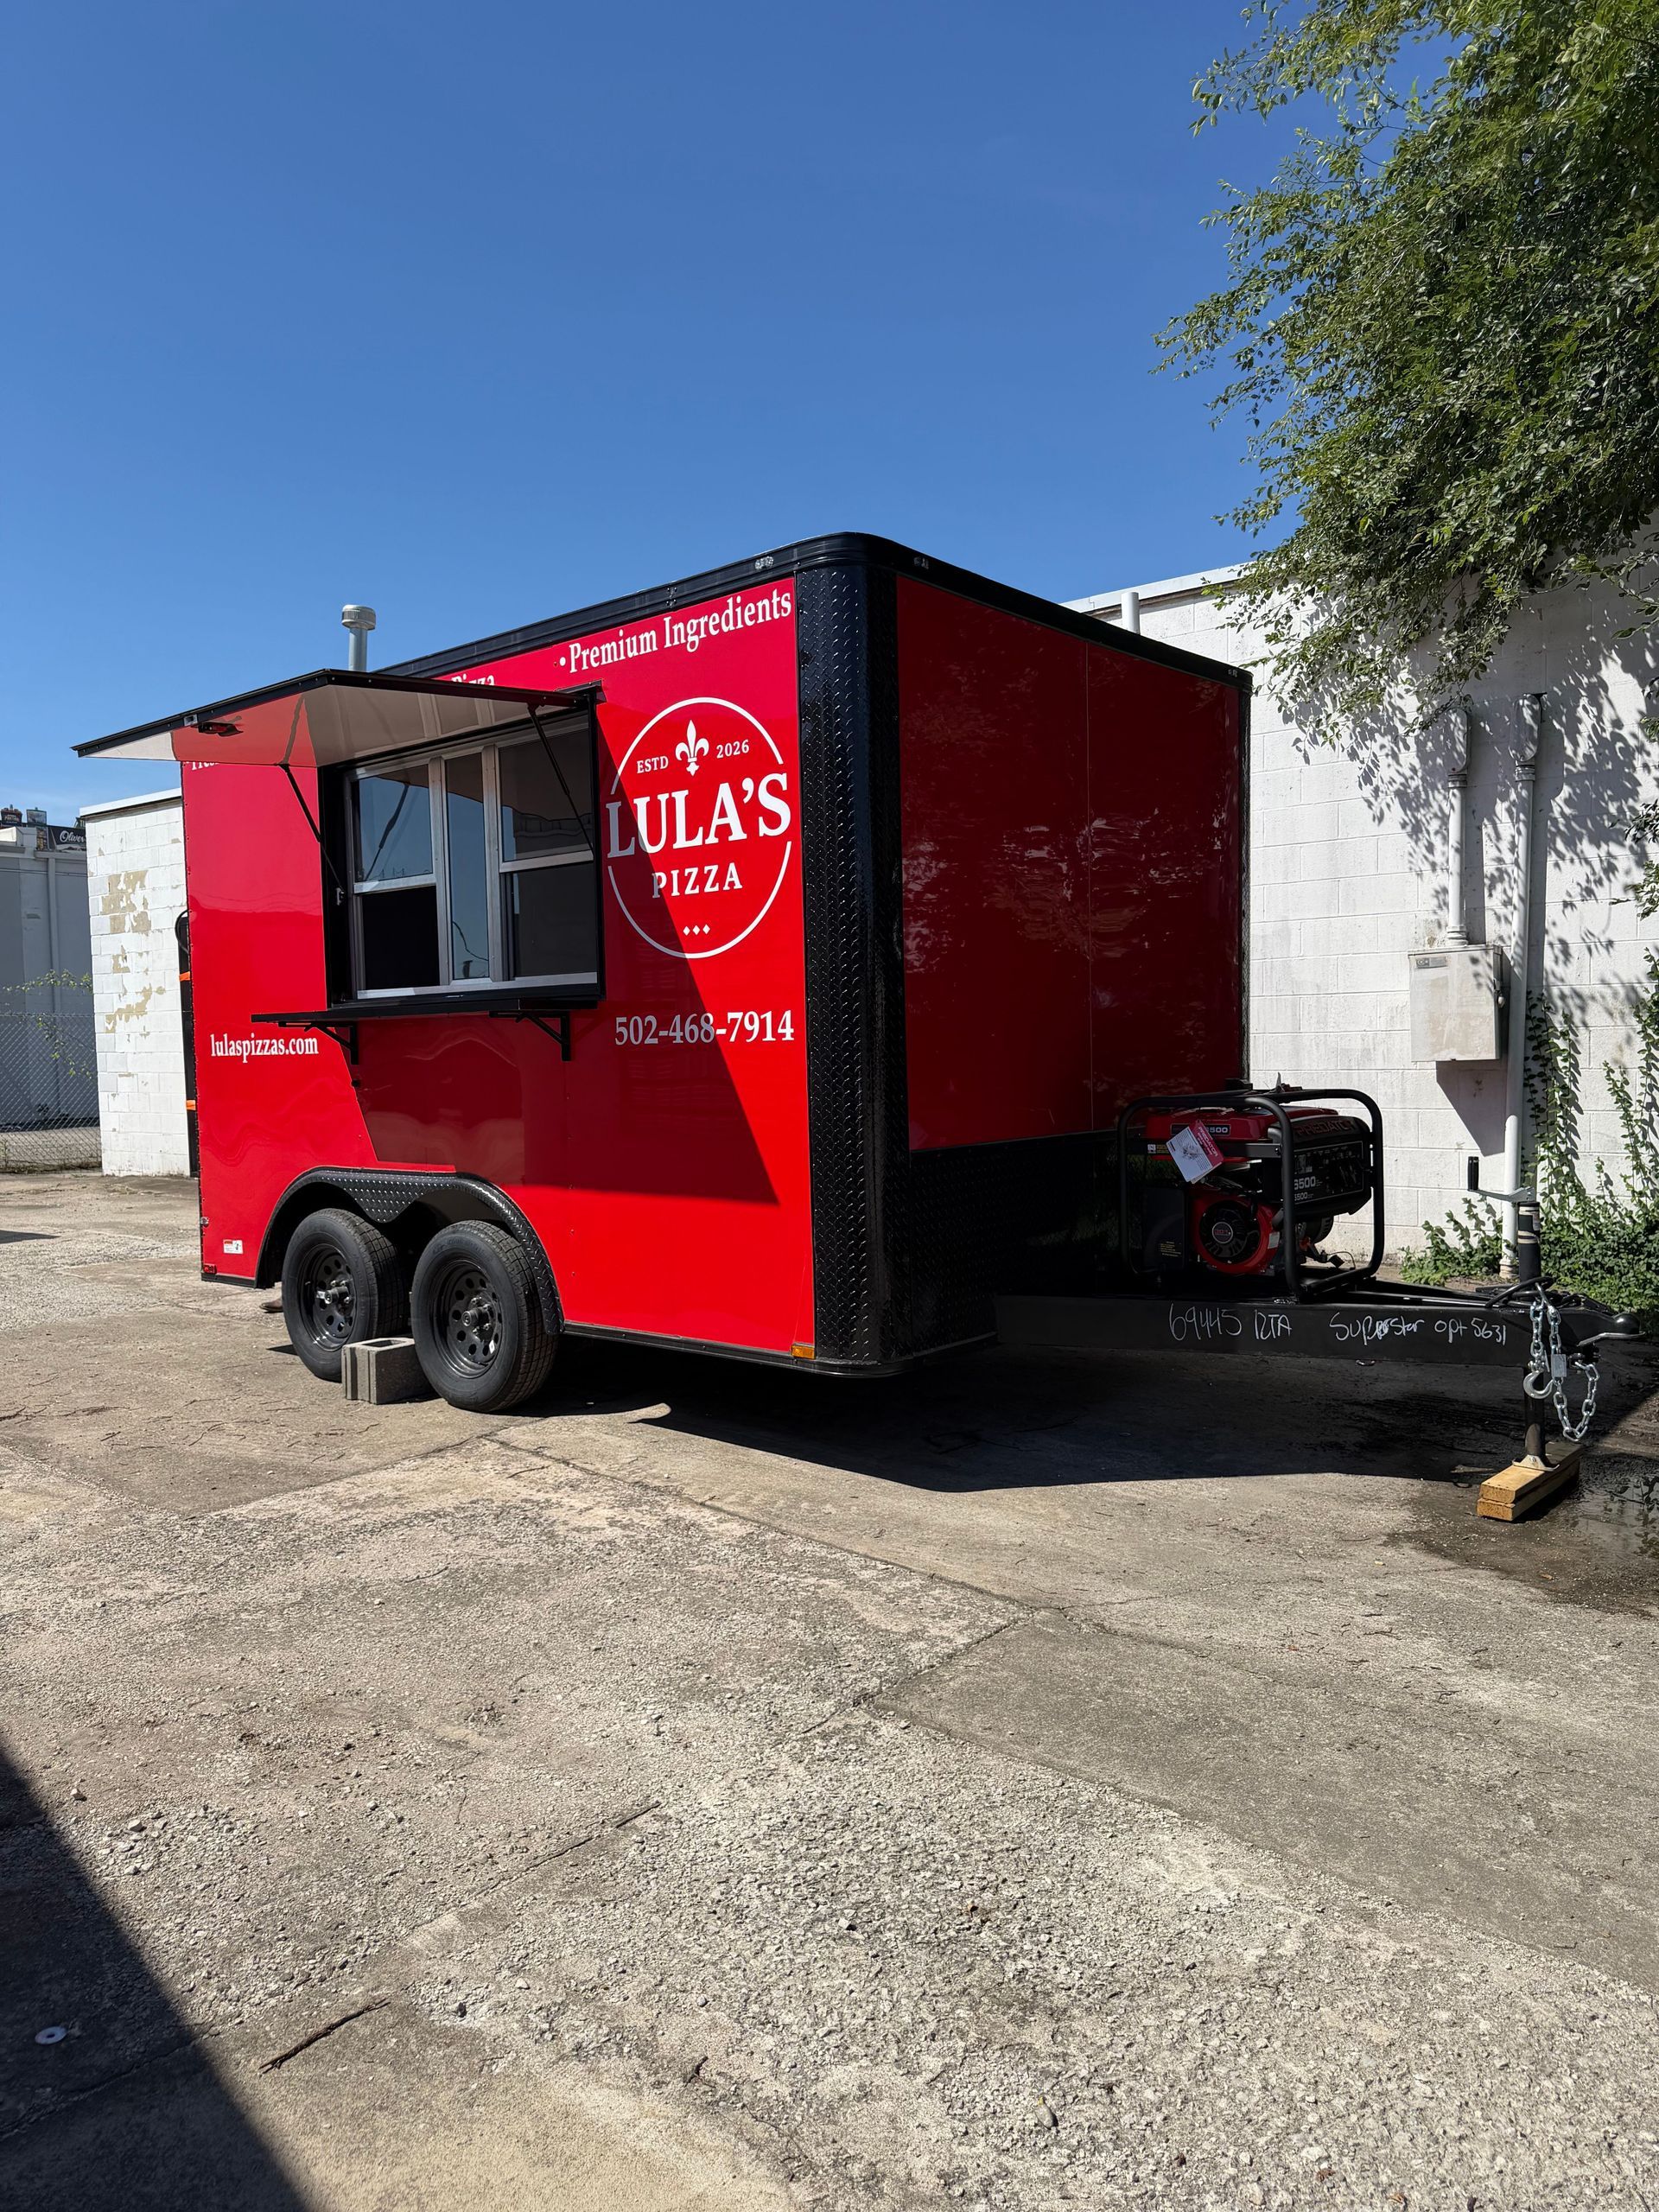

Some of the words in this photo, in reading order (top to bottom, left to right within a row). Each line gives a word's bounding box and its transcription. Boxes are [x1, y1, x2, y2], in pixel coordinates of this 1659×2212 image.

[569, 628, 658, 673] Premium
[663, 588, 792, 652] Ingredients
[636, 755, 670, 774] ESTD
[715, 739, 751, 760] 2026
[605, 772, 791, 859] LULA'S
[652, 861, 743, 899] PIZZA
[614, 1009, 795, 1046] 502-468-7914
[209, 1033, 320, 1063] lulaspizzas.com
[1169, 1303, 1243, 1341] 69445
[1471, 1317, 1507, 1346] 5631
